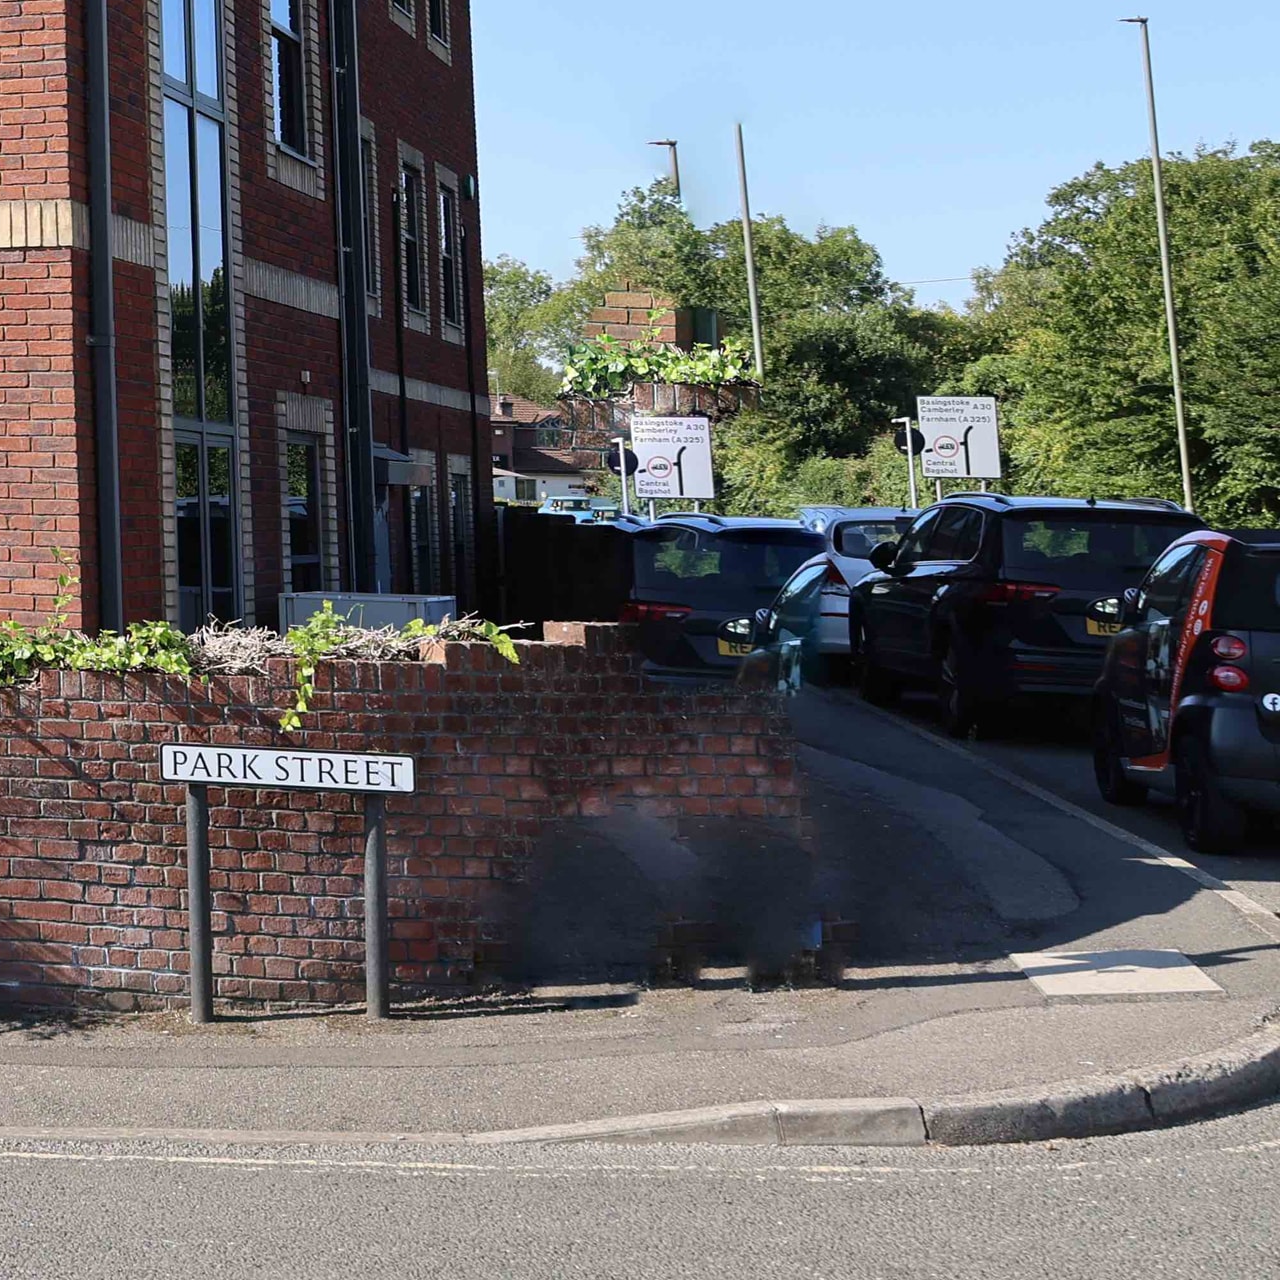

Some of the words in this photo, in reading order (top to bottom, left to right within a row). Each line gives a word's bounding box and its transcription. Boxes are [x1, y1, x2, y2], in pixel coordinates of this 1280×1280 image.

[920, 406, 964, 414] Camberley
[671, 436, 705, 444] (A325)
[172, 751, 263, 780] PARK
[275, 756, 403, 787] STREET
